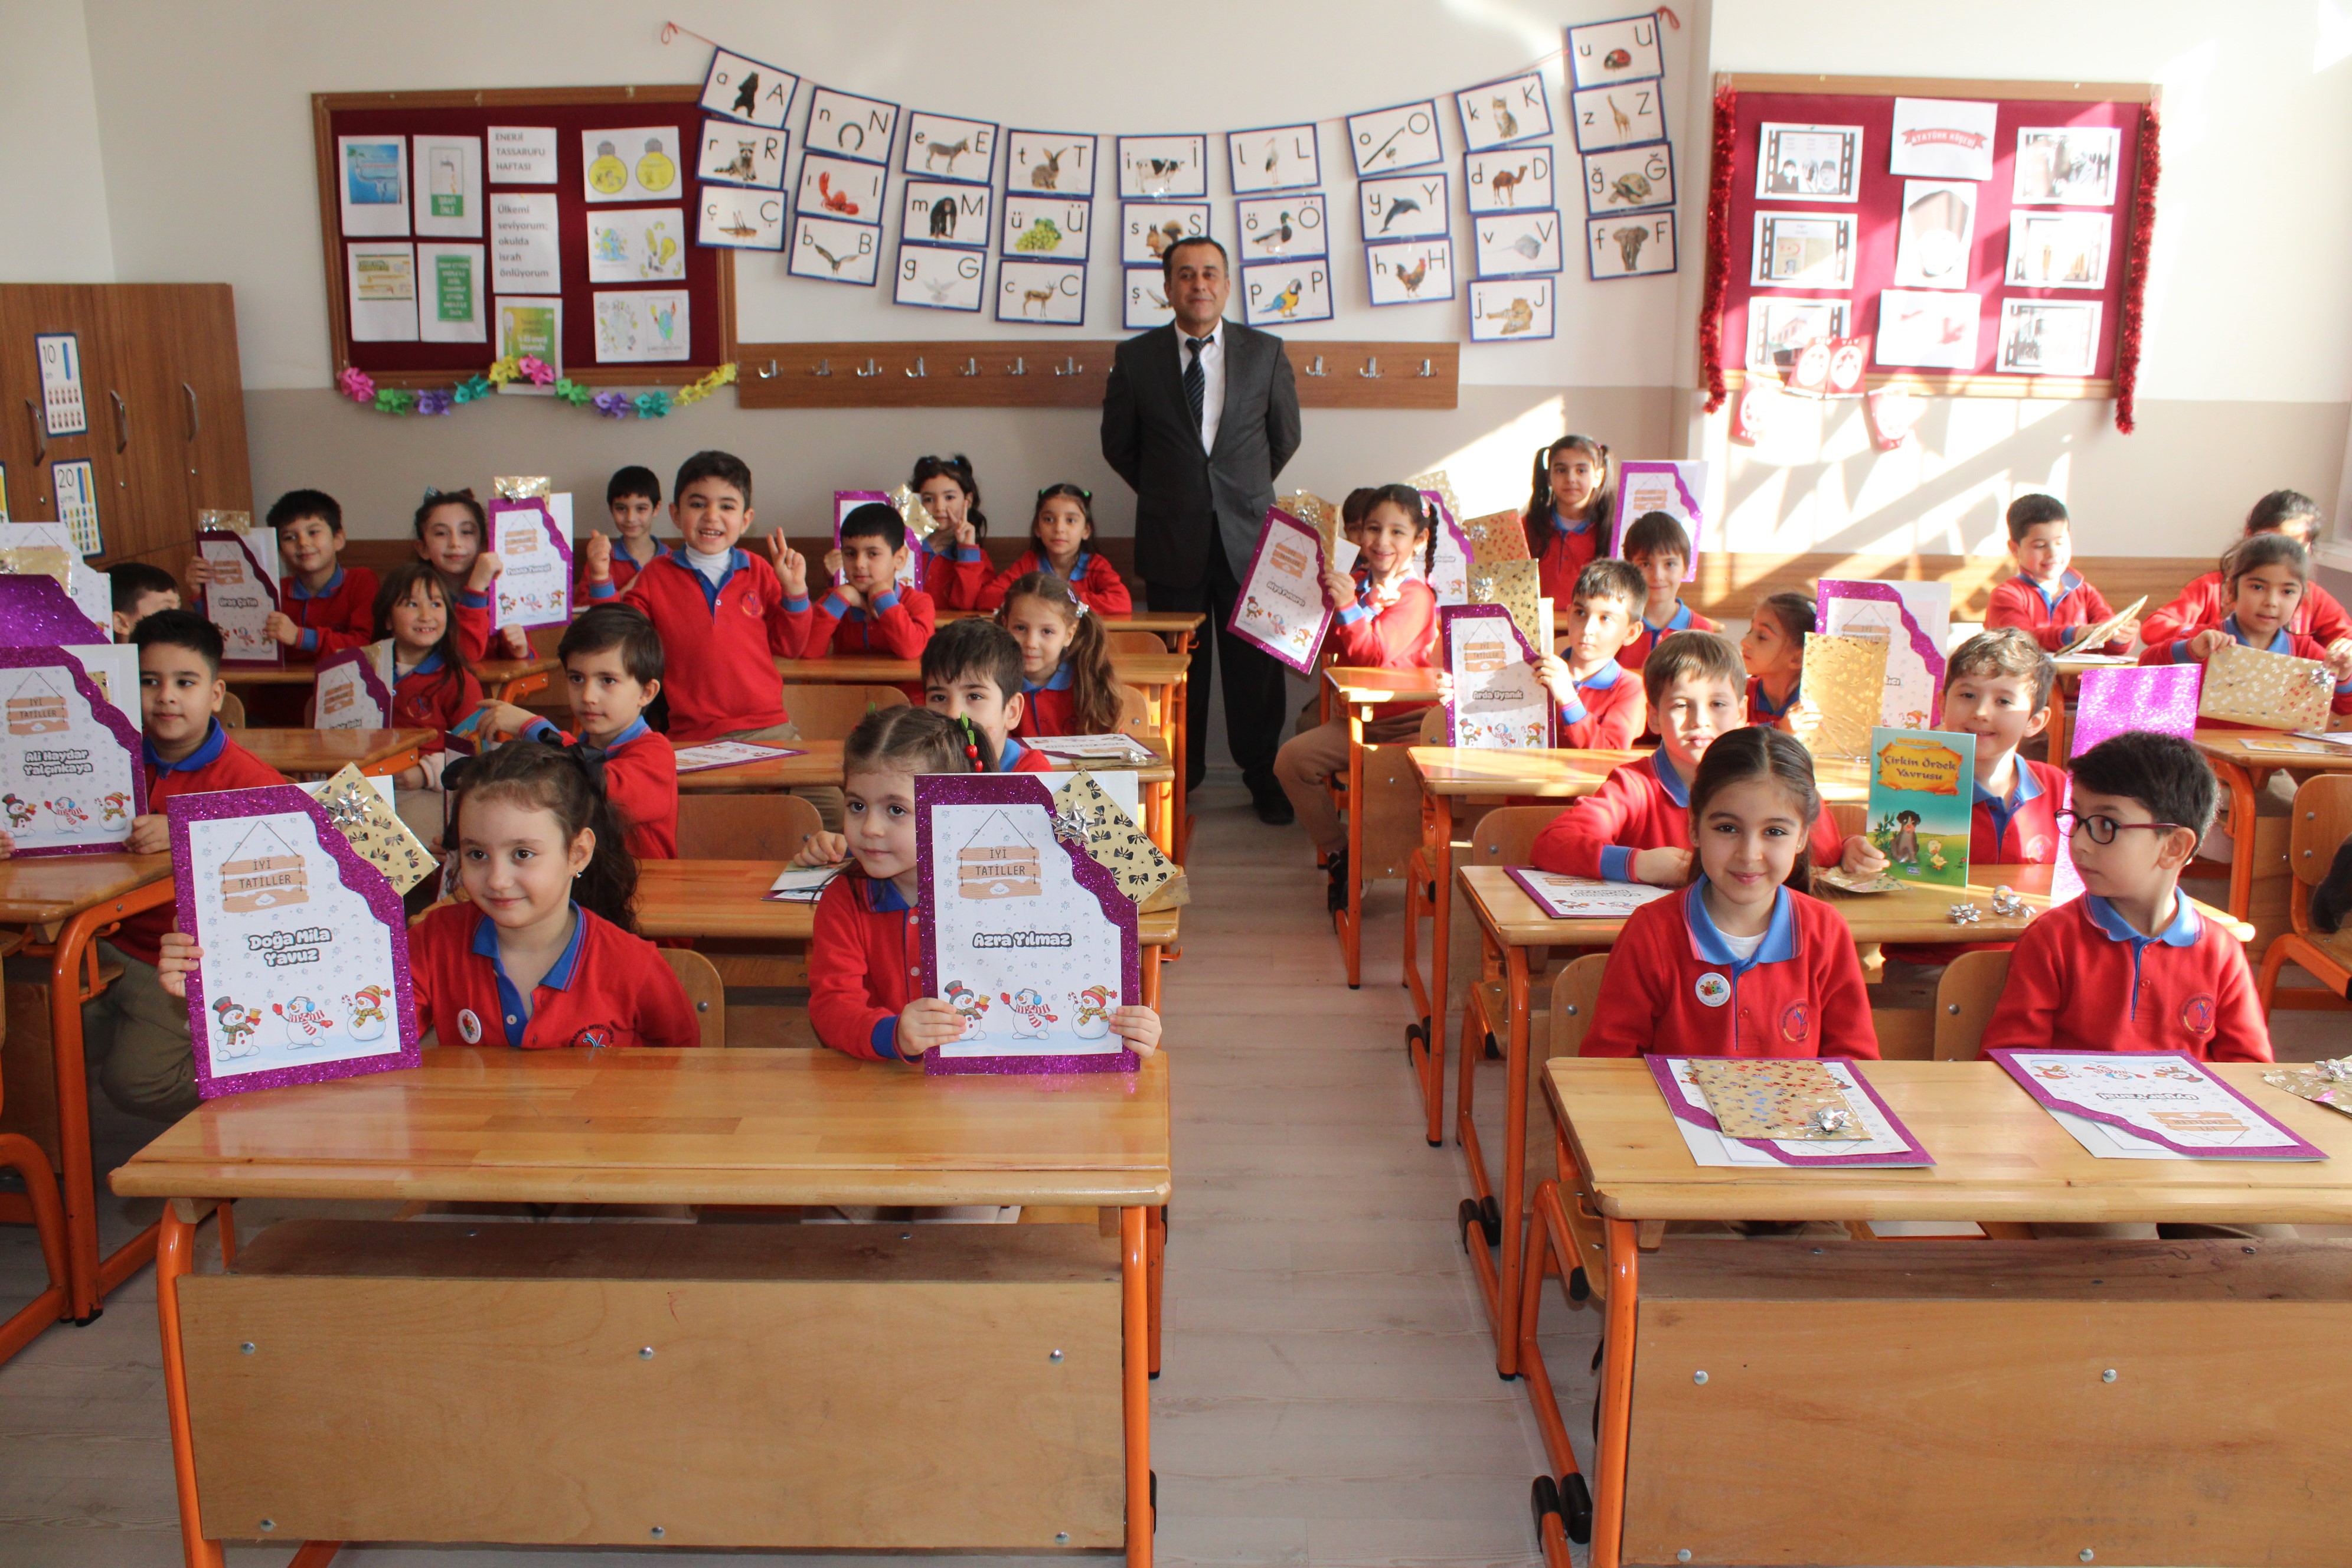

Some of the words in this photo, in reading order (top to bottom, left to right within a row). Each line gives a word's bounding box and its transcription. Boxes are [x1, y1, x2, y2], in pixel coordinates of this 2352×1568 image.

[1580, 45, 1591, 57] u
[1635, 24, 1652, 46] U
[717, 73, 728, 85] a
[766, 83, 783, 106] A
[1467, 100, 1479, 120] k
[1523, 84, 1538, 107] K
[1584, 112, 1594, 125] z
[1636, 92, 1652, 115] Z
[819, 109, 830, 121] n
[869, 110, 888, 133] N
[1360, 133, 1371, 145] o
[1408, 112, 1430, 135] O
[495, 132, 523, 141] ENERJİ
[915, 132, 925, 143] e
[975, 131, 989, 153] E
[496, 147, 545, 156] TASSARUFU
[709, 139, 718, 150] r
[765, 137, 778, 159] R
[1020, 148, 1025, 164] t
[1074, 146, 1086, 167] T
[1239, 144, 1245, 164] l
[496, 162, 531, 170] HAFTASI
[1472, 163, 1482, 184] d
[1533, 158, 1548, 180] D
[1592, 168, 1603, 194] ğ
[1645, 153, 1667, 181] Ğ
[498, 203, 530, 214] Ülkemi
[912, 200, 928, 211] m
[961, 194, 983, 216] M
[1370, 194, 1381, 215] y
[1423, 183, 1438, 204] Y
[707, 204, 717, 219] ç
[760, 200, 779, 227] Ç
[1011, 212, 1021, 228] ü
[1067, 204, 1083, 232] Ü
[1246, 213, 1257, 230] ö
[1298, 200, 1320, 228] Ö
[1132, 223, 1139, 234] s
[1188, 214, 1201, 236] S
[1484, 232, 1494, 243] v
[1536, 221, 1553, 242] V
[1596, 228, 1605, 249] f
[1656, 221, 1667, 243] F
[498, 237, 530, 245] okulda
[803, 227, 813, 246] b
[859, 233, 871, 254] B
[904, 260, 916, 280] g
[958, 257, 979, 279] G
[1375, 254, 1386, 274] h
[1428, 249, 1445, 270] H
[499, 267, 549, 278] önlüyorum
[1005, 282, 1015, 293] c
[1060, 275, 1079, 296] C
[1132, 288, 1139, 304] ş
[1250, 284, 1262, 305] p
[1312, 271, 1323, 293] P
[1475, 292, 1482, 319] j
[1534, 286, 1544, 307] J
[43, 344, 56, 364] 10
[57, 468, 74, 488] 20
[30, 697, 43, 707] İYİ
[1473, 691, 1493, 700] Arda
[1493, 690, 1523, 701] Uyanık
[19, 709, 57, 720] TATİLLER
[25, 750, 43, 763] Ali
[43, 749, 89, 763] Haydar
[1884, 755, 1919, 766] Çirkin
[1922, 757, 1956, 770] Ördek
[24, 761, 93, 776] Yalçınkaya
[1896, 768, 1943, 780] Yavrusu
[989, 847, 1007, 859] İYİ
[253, 858, 271, 871] İYİ
[975, 864, 1025, 876] TATİLLER
[239, 874, 292, 888] TATİLLER
[248, 930, 295, 950] Doğa
[295, 927, 332, 945] Mila
[972, 932, 1014, 948] Azra
[1013, 931, 1072, 948] Yılmaz
[264, 948, 320, 968] Yavuz
